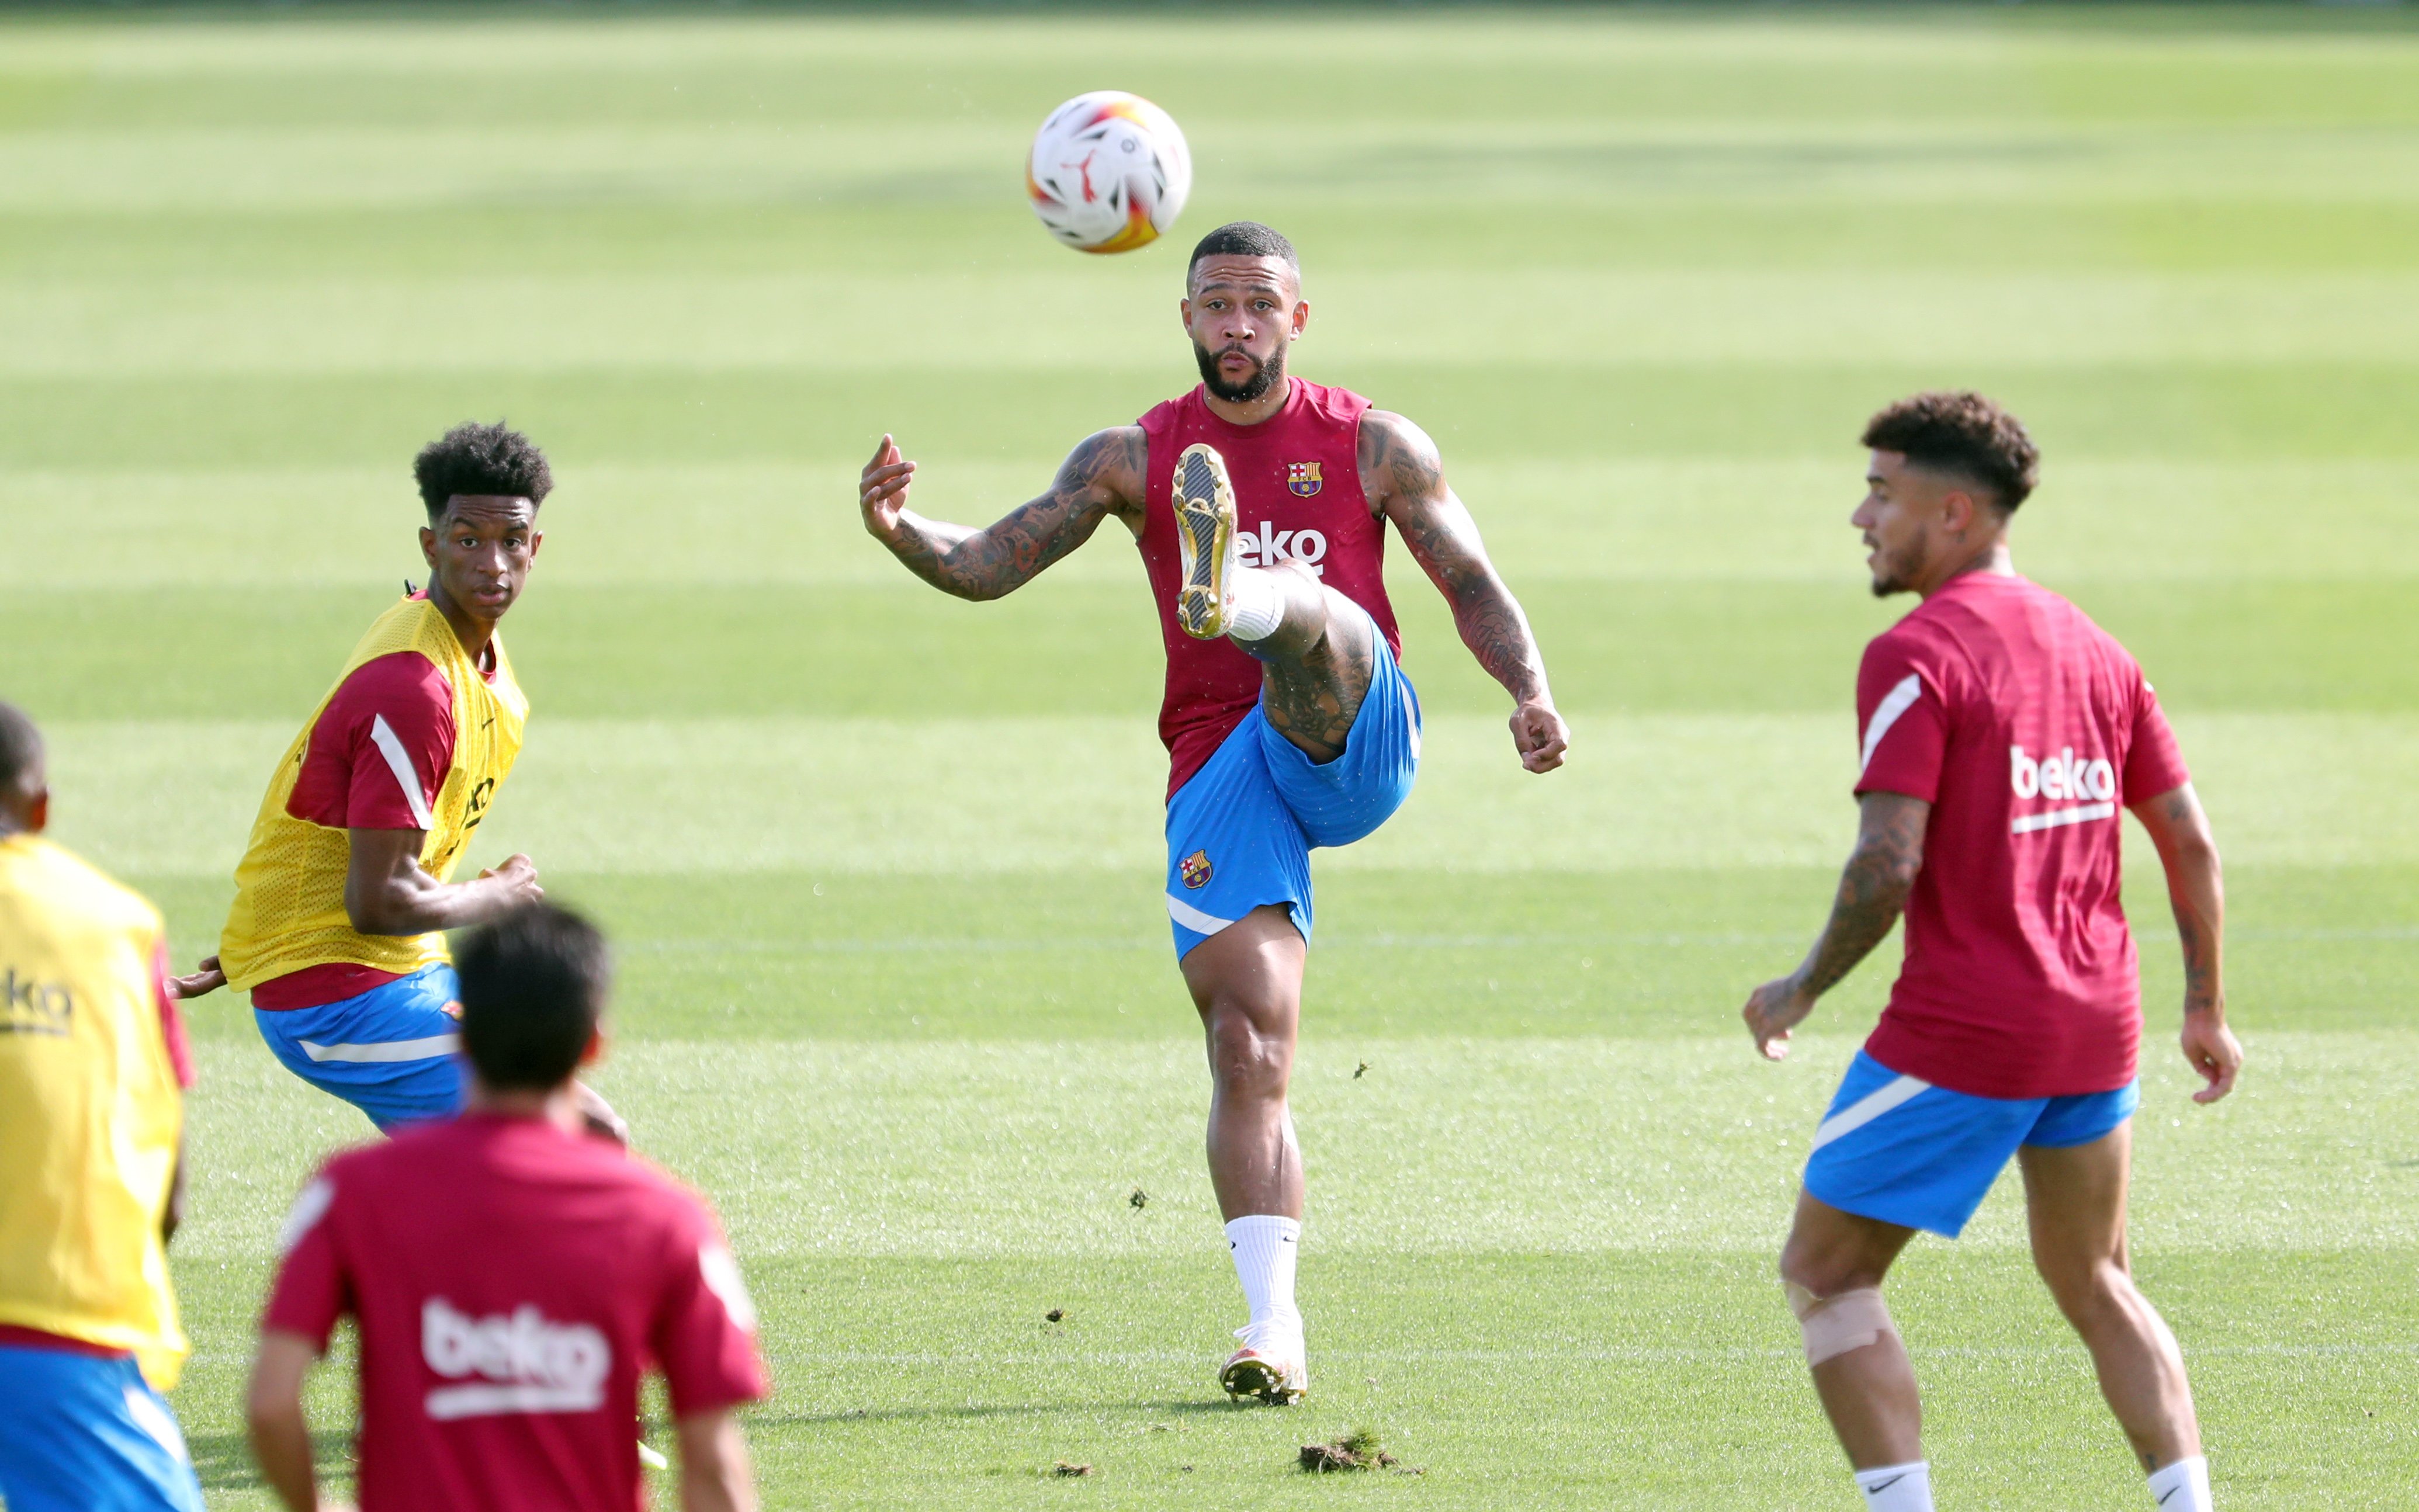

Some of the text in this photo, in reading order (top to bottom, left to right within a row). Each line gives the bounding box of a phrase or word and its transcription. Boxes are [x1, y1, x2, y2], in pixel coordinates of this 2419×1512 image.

[1236, 521, 1327, 568] eko
[2010, 744, 2116, 801] beko
[1, 968, 72, 1022] ko
[421, 1296, 613, 1387] beko
